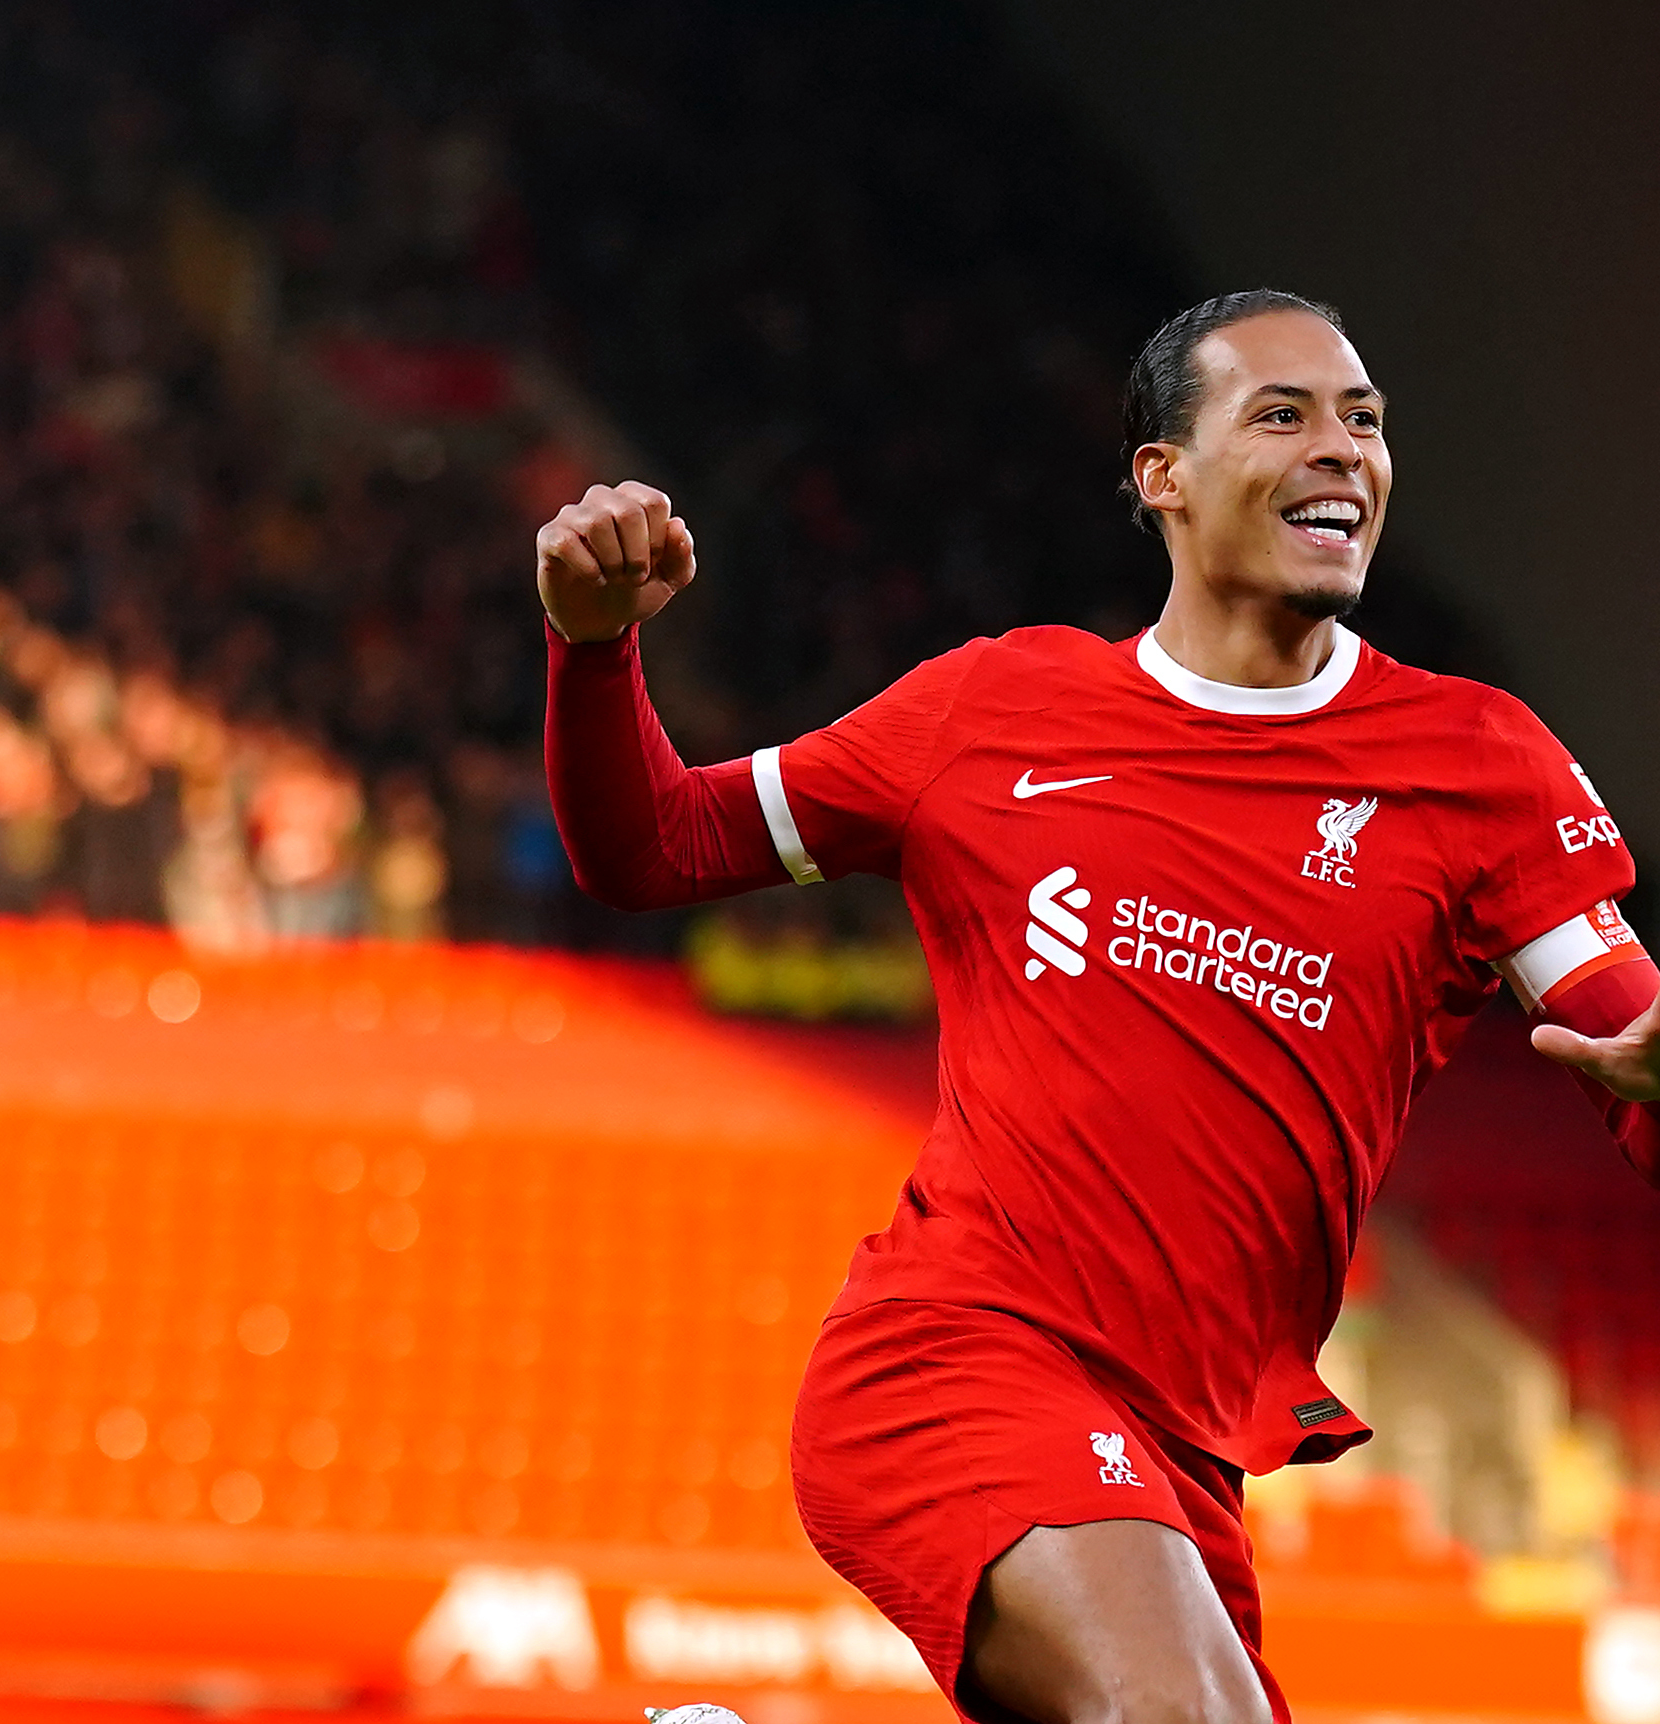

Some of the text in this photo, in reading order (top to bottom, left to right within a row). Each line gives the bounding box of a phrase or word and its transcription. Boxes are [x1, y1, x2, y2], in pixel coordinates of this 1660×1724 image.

[1300, 855, 1356, 889] L.F.C.
[1107, 932, 1334, 1031] chartered
[1112, 895, 1334, 988] standard
